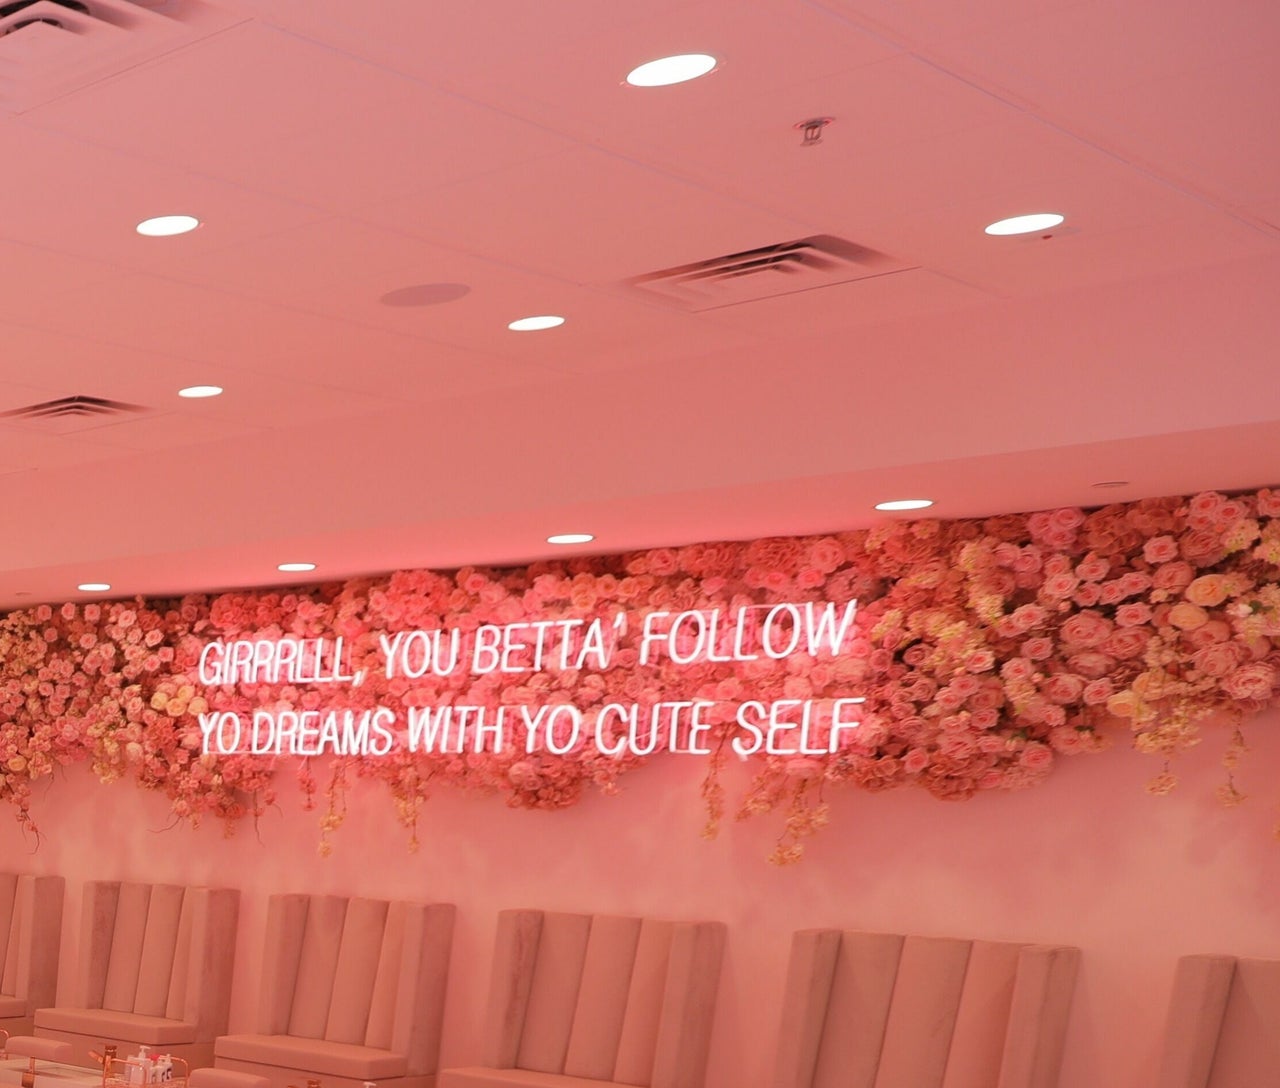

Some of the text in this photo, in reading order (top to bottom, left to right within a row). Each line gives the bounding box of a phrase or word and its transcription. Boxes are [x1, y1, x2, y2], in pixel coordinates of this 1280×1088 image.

[198, 598, 857, 687] GIRRRLLL, YOU BETTA' FOLLOW
[198, 697, 866, 756] YO DREAMS WITH YO CUTE SELF
